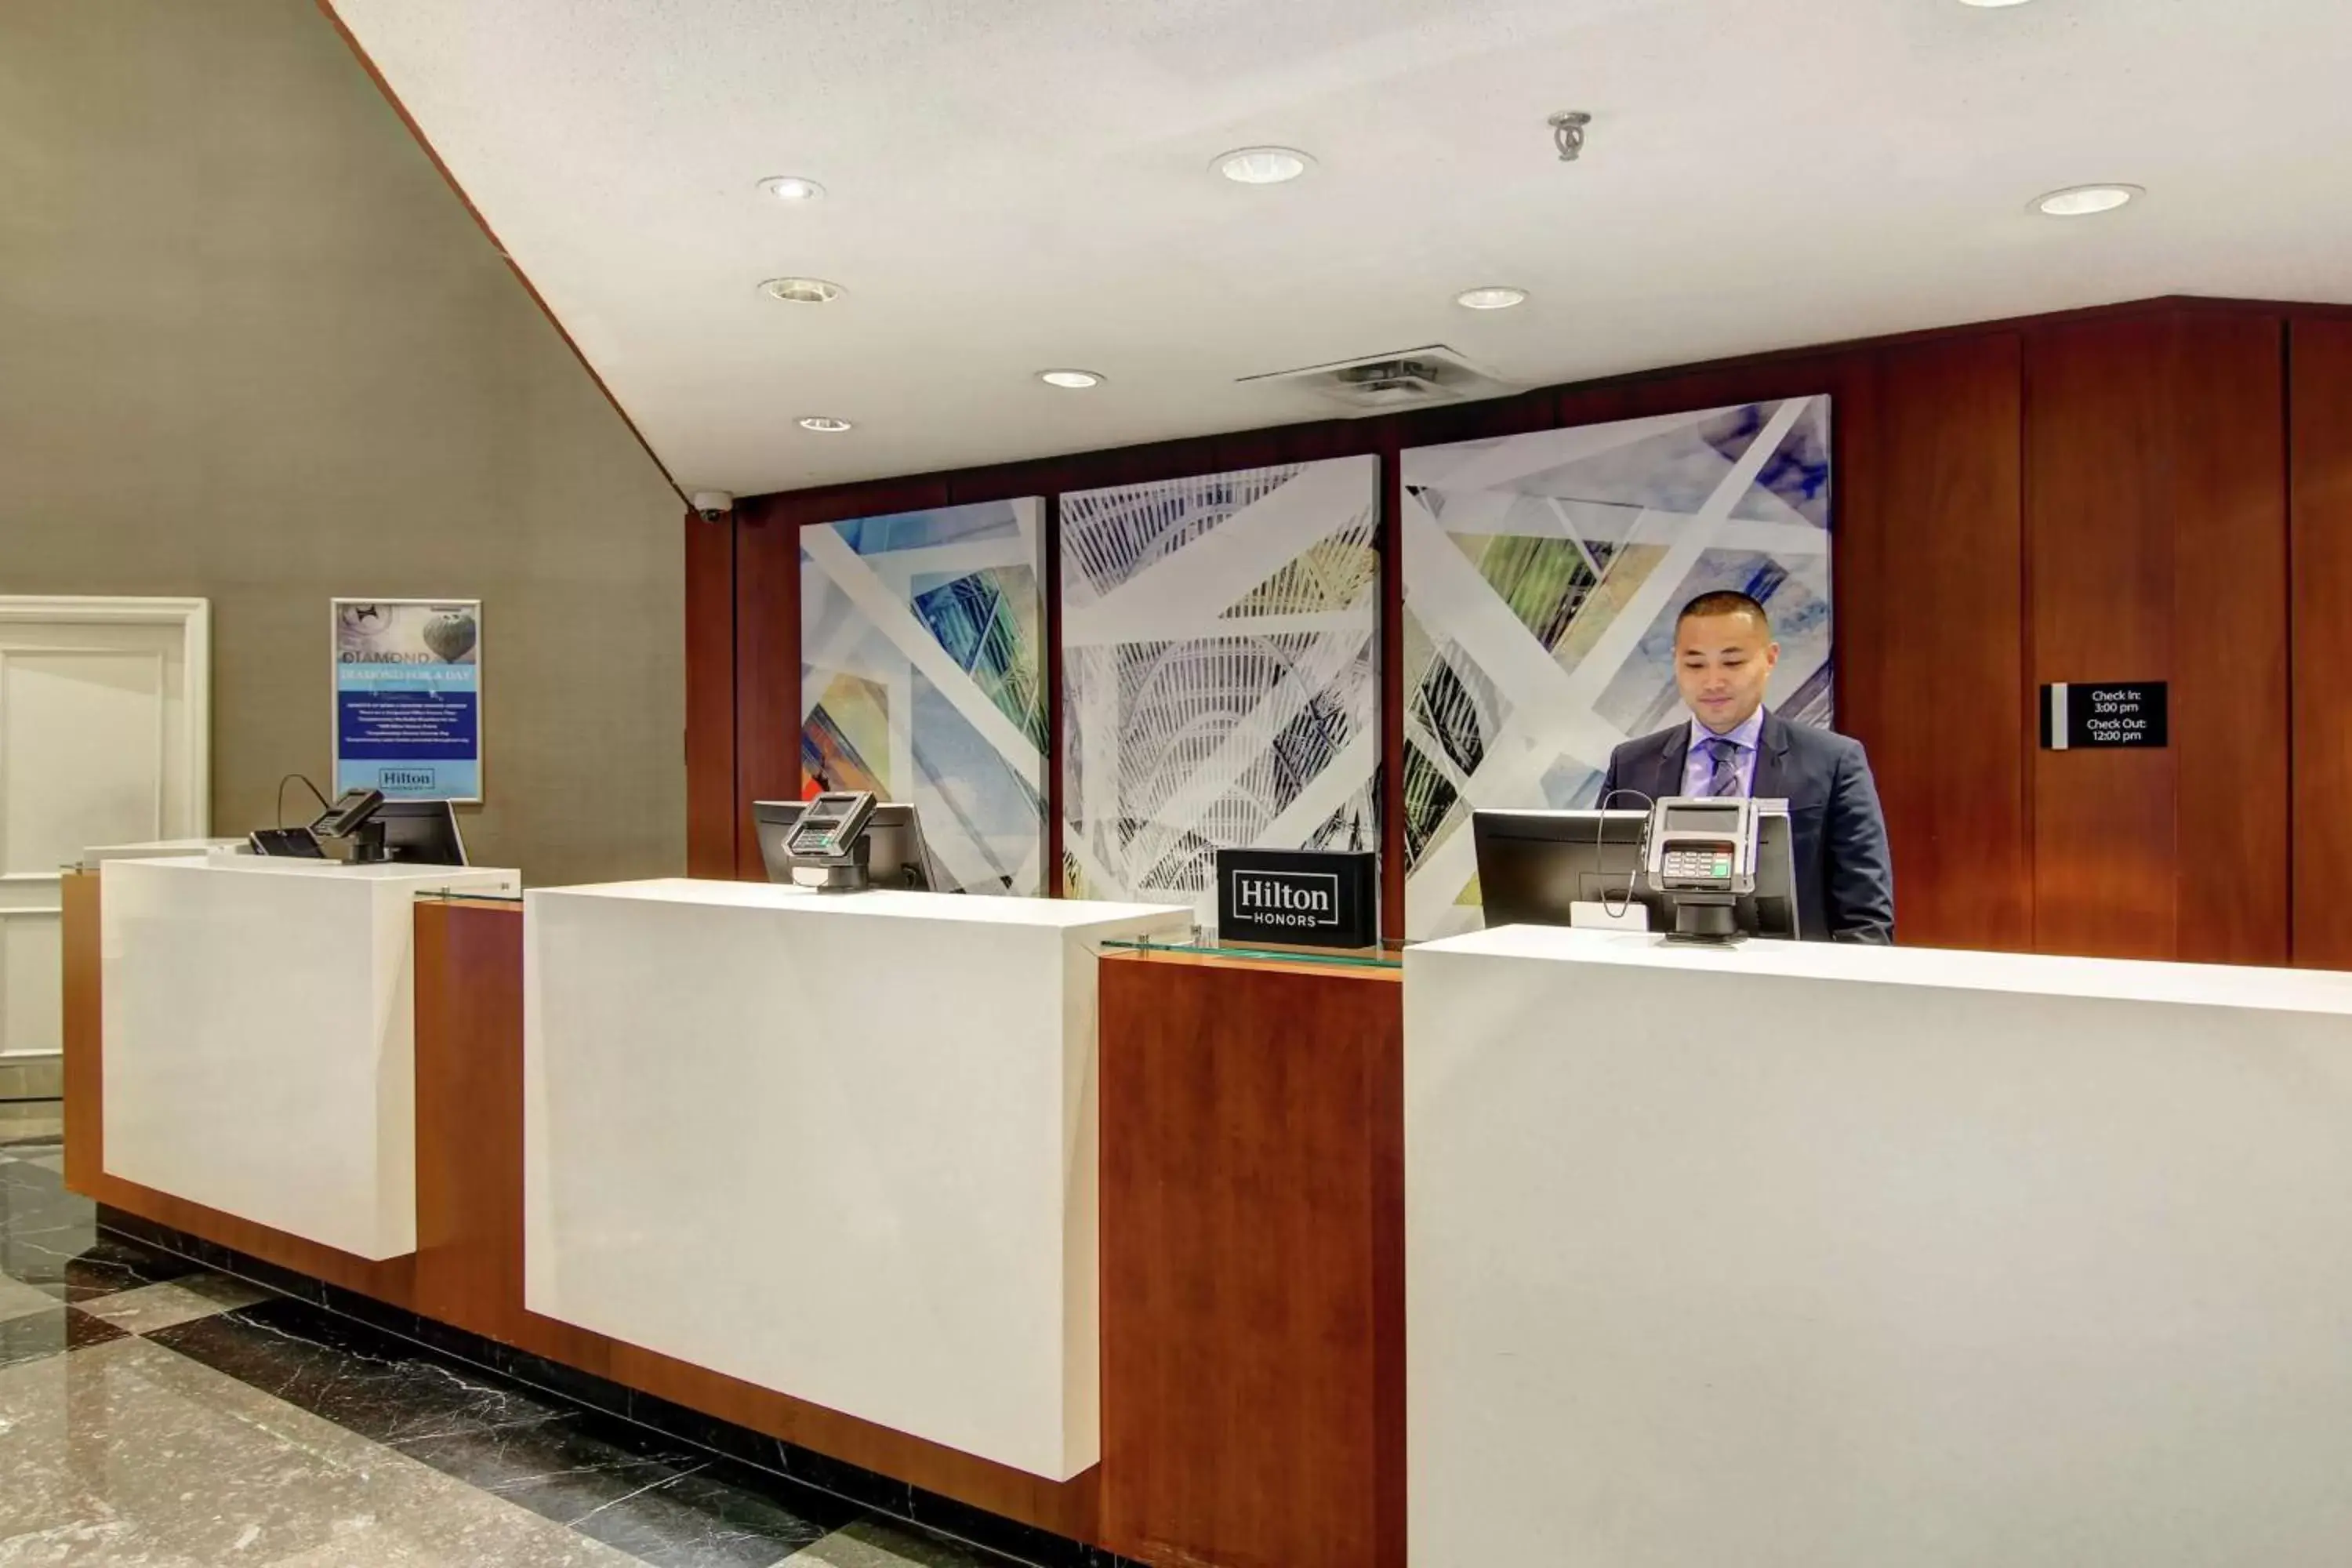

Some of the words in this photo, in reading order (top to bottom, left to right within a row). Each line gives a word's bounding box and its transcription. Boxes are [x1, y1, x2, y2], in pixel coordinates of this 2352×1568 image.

[343, 652, 430, 663] DIAMOND
[2092, 690, 2125, 701] Check
[2128, 690, 2141, 699] In:
[2094, 702, 2118, 713] 3:00
[2119, 703, 2139, 714] pm
[2086, 718, 2121, 729] Check
[2122, 718, 2147, 728] Out:
[2092, 731, 2120, 741] 12:00
[2123, 732, 2141, 742] pm
[384, 772, 430, 784] Hilton
[1241, 880, 1329, 910] Hilton
[1254, 912, 1316, 927] HONORS
